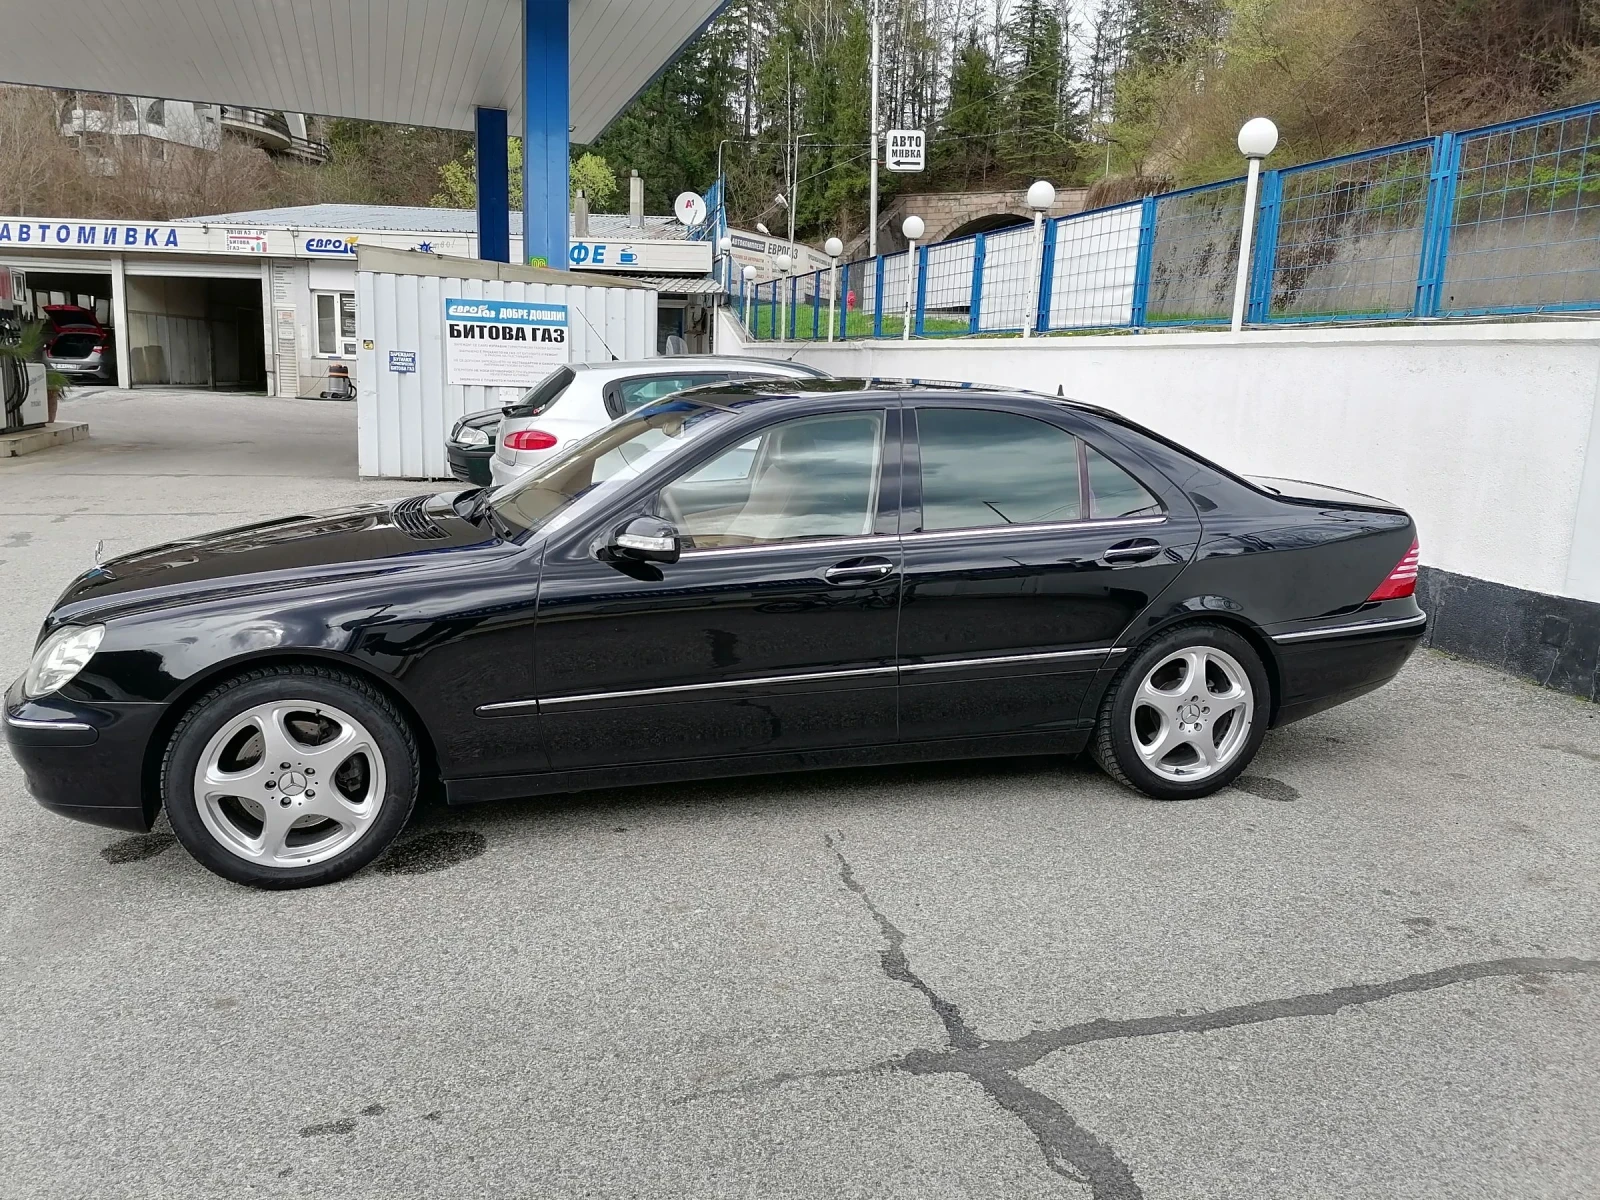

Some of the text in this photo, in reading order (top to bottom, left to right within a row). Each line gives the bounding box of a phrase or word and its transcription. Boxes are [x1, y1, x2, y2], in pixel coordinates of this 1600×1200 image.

[892, 136, 922, 147] АВТО
[892, 149, 921, 158] МИВКА
[0, 223, 179, 247] АВТОМИВКА
[768, 243, 799, 260] ЕВРОГЗ
[499, 308, 528, 320] ДОБРЕ
[529, 309, 566, 321] ДОШЛИ!
[449, 324, 565, 343] БИТОВА ГАЗ
